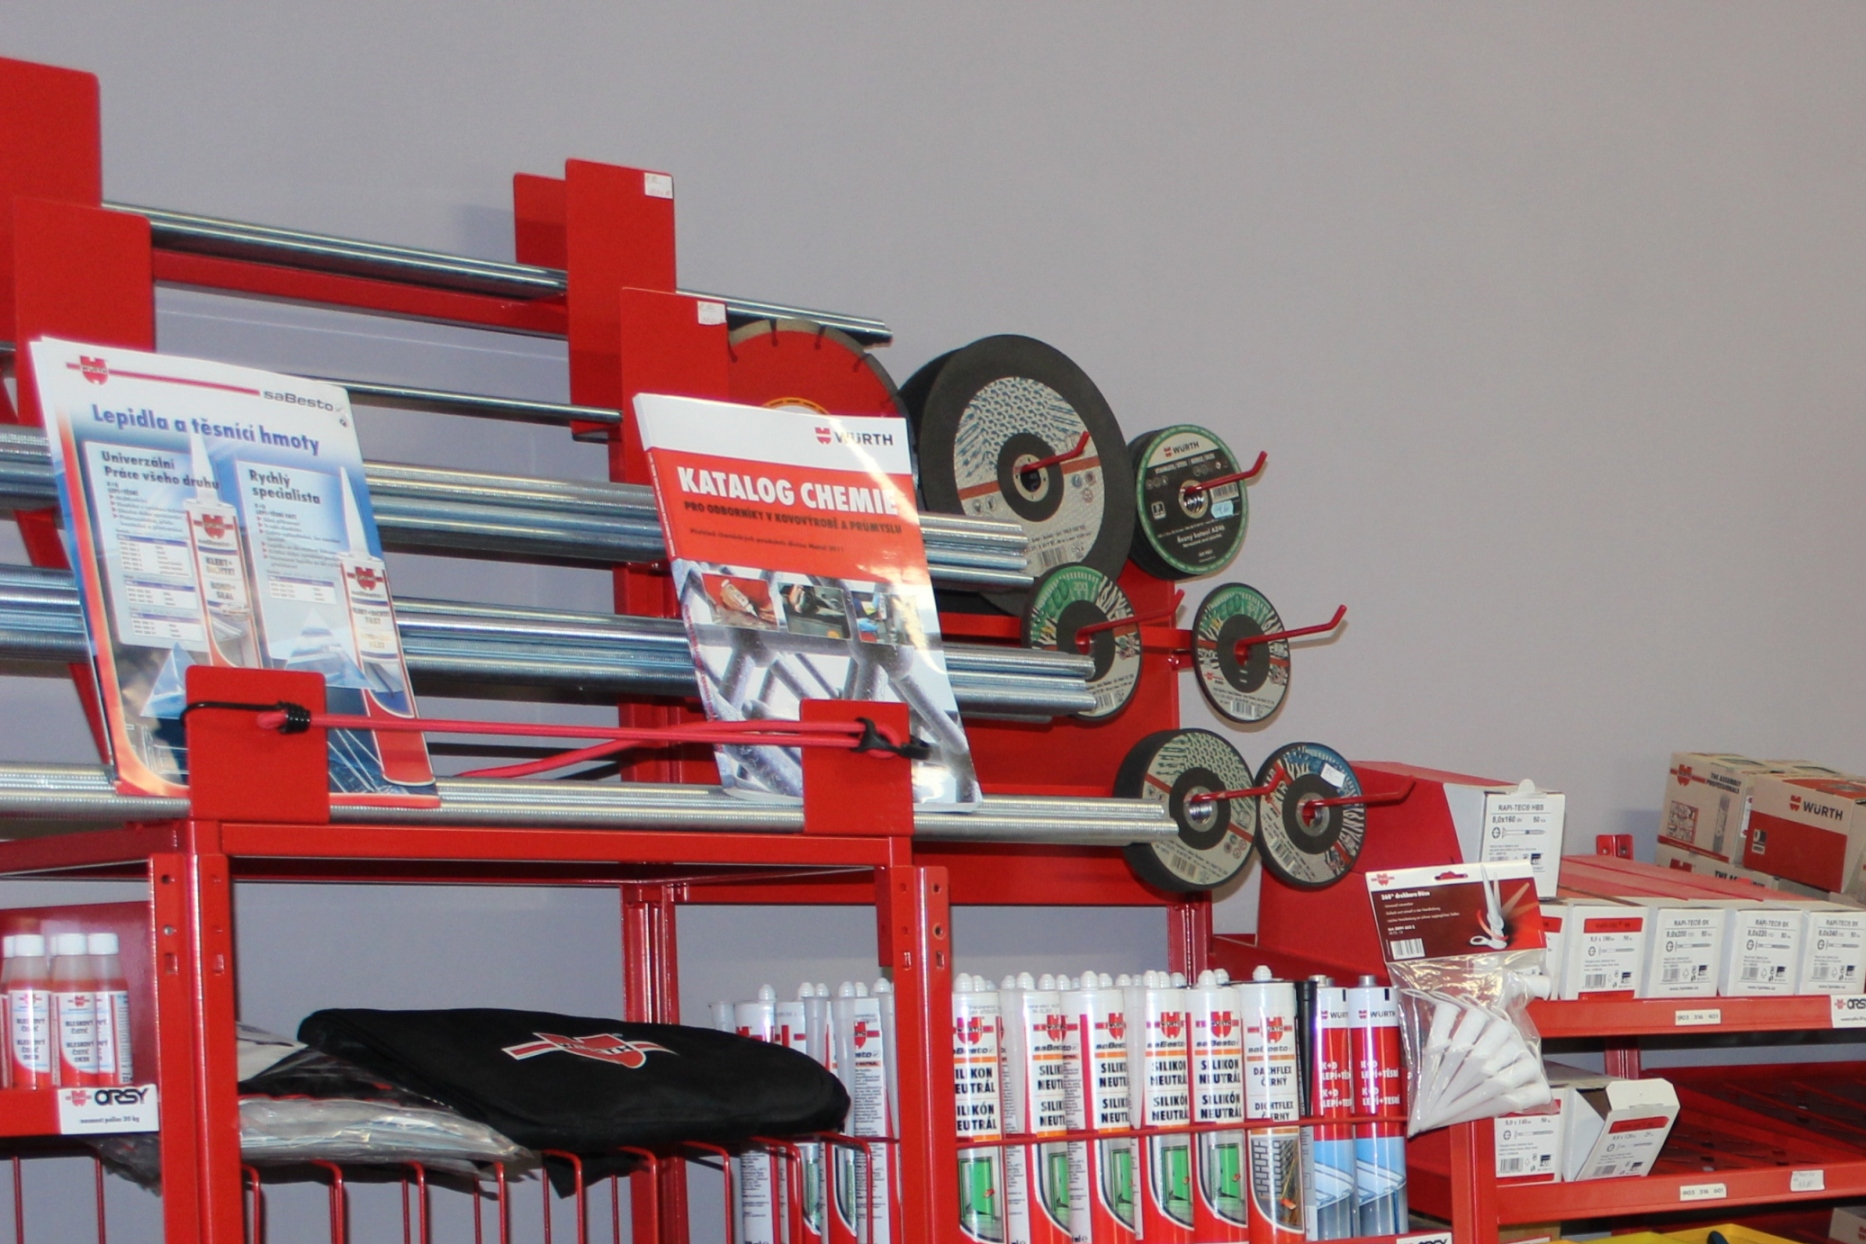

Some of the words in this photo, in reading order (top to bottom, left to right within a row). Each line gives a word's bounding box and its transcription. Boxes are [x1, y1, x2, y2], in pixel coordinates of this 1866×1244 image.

[264, 390, 334, 412] saBesto
[92, 404, 169, 431] Lepidla
[175, 418, 187, 432] a
[260, 424, 319, 456] hmoty
[834, 429, 894, 447] WÜRTH
[1173, 442, 1200, 454] WÜRTH
[104, 466, 139, 480] Práce
[142, 470, 178, 486] všeho
[182, 476, 220, 490] druhu
[249, 469, 290, 488] Rychlý
[252, 486, 321, 505] specialista
[677, 466, 795, 506] KATALOG
[800, 481, 898, 516] CHEMIE
[684, 501, 705, 513] PRO
[707, 503, 764, 521] ODBORNÍKY
[767, 513, 773, 523] V
[841, 520, 848, 530] A
[1803, 802, 1843, 821] WÜRTH
[1253, 1066, 1292, 1076] DAHFLEX
[955, 1082, 995, 1094] EUTRÁL
[1261, 1077, 1287, 1087] ČRNÝ
[94, 1088, 148, 1106] ORSY
[956, 1118, 997, 1131] EUTRÁL
